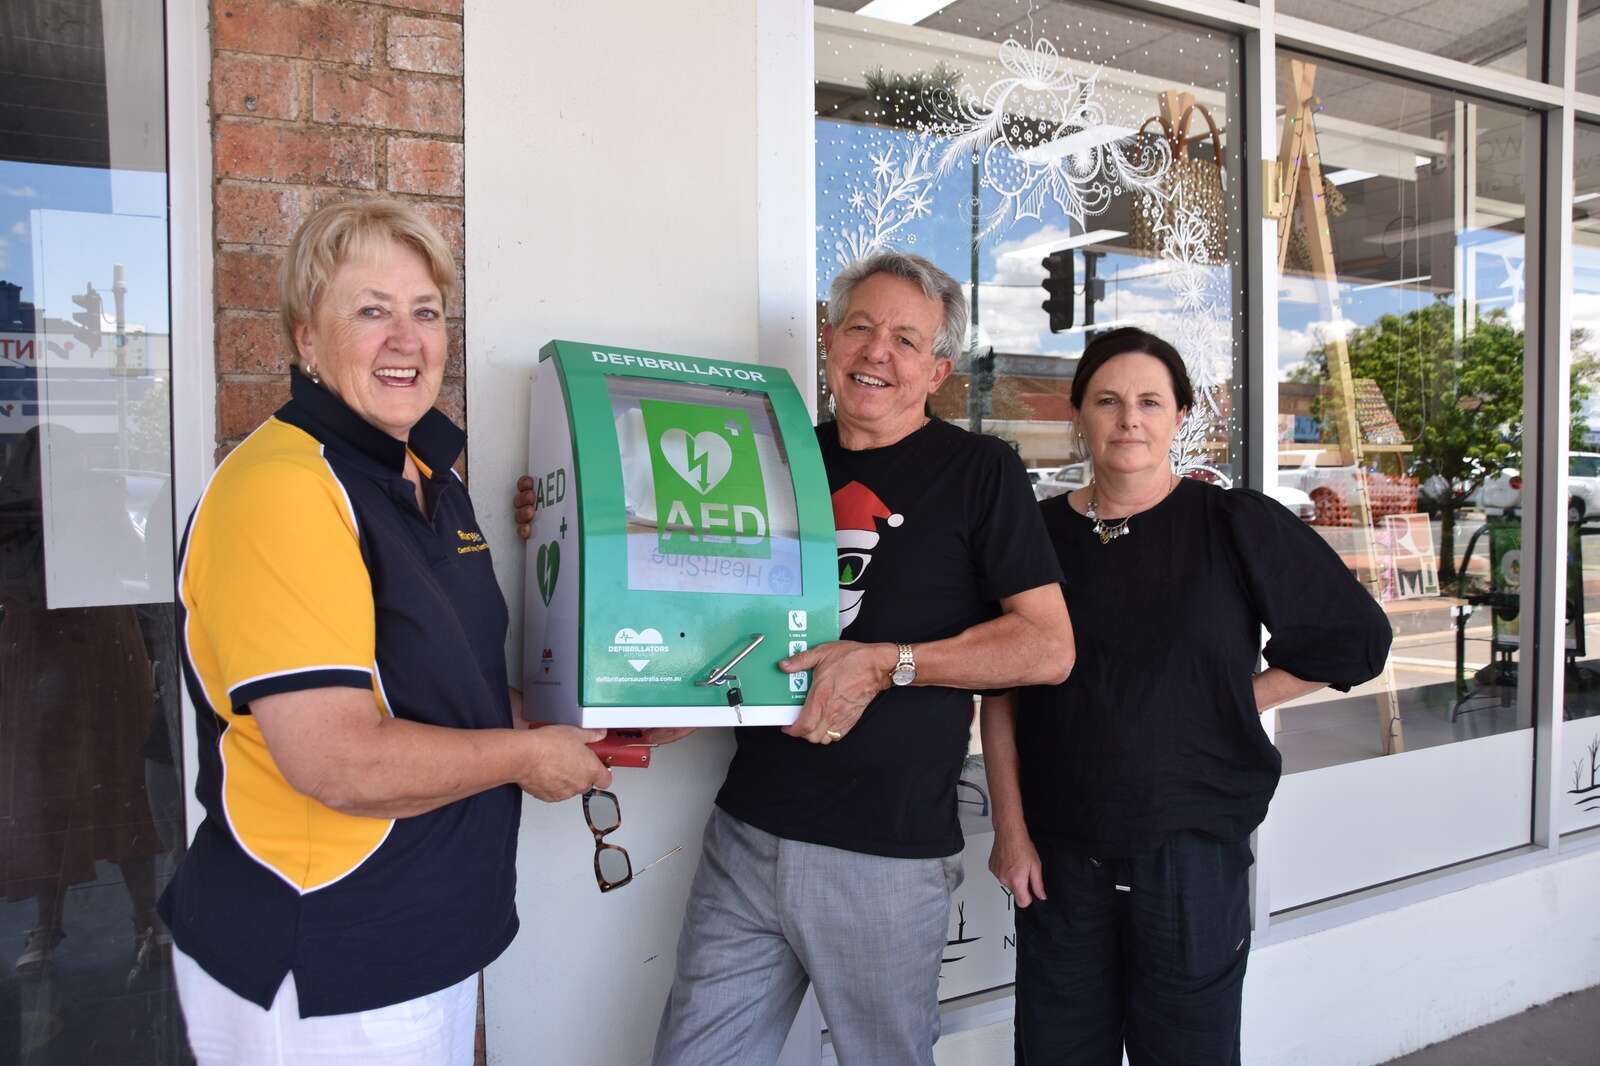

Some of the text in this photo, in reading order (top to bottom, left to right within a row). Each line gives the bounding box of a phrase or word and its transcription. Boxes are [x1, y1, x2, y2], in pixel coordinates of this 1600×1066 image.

[592, 351, 766, 383] DEFIBRILLATOR
[535, 468, 566, 511] AED
[662, 500, 766, 545] AED
[650, 550, 763, 588] HeartSine
